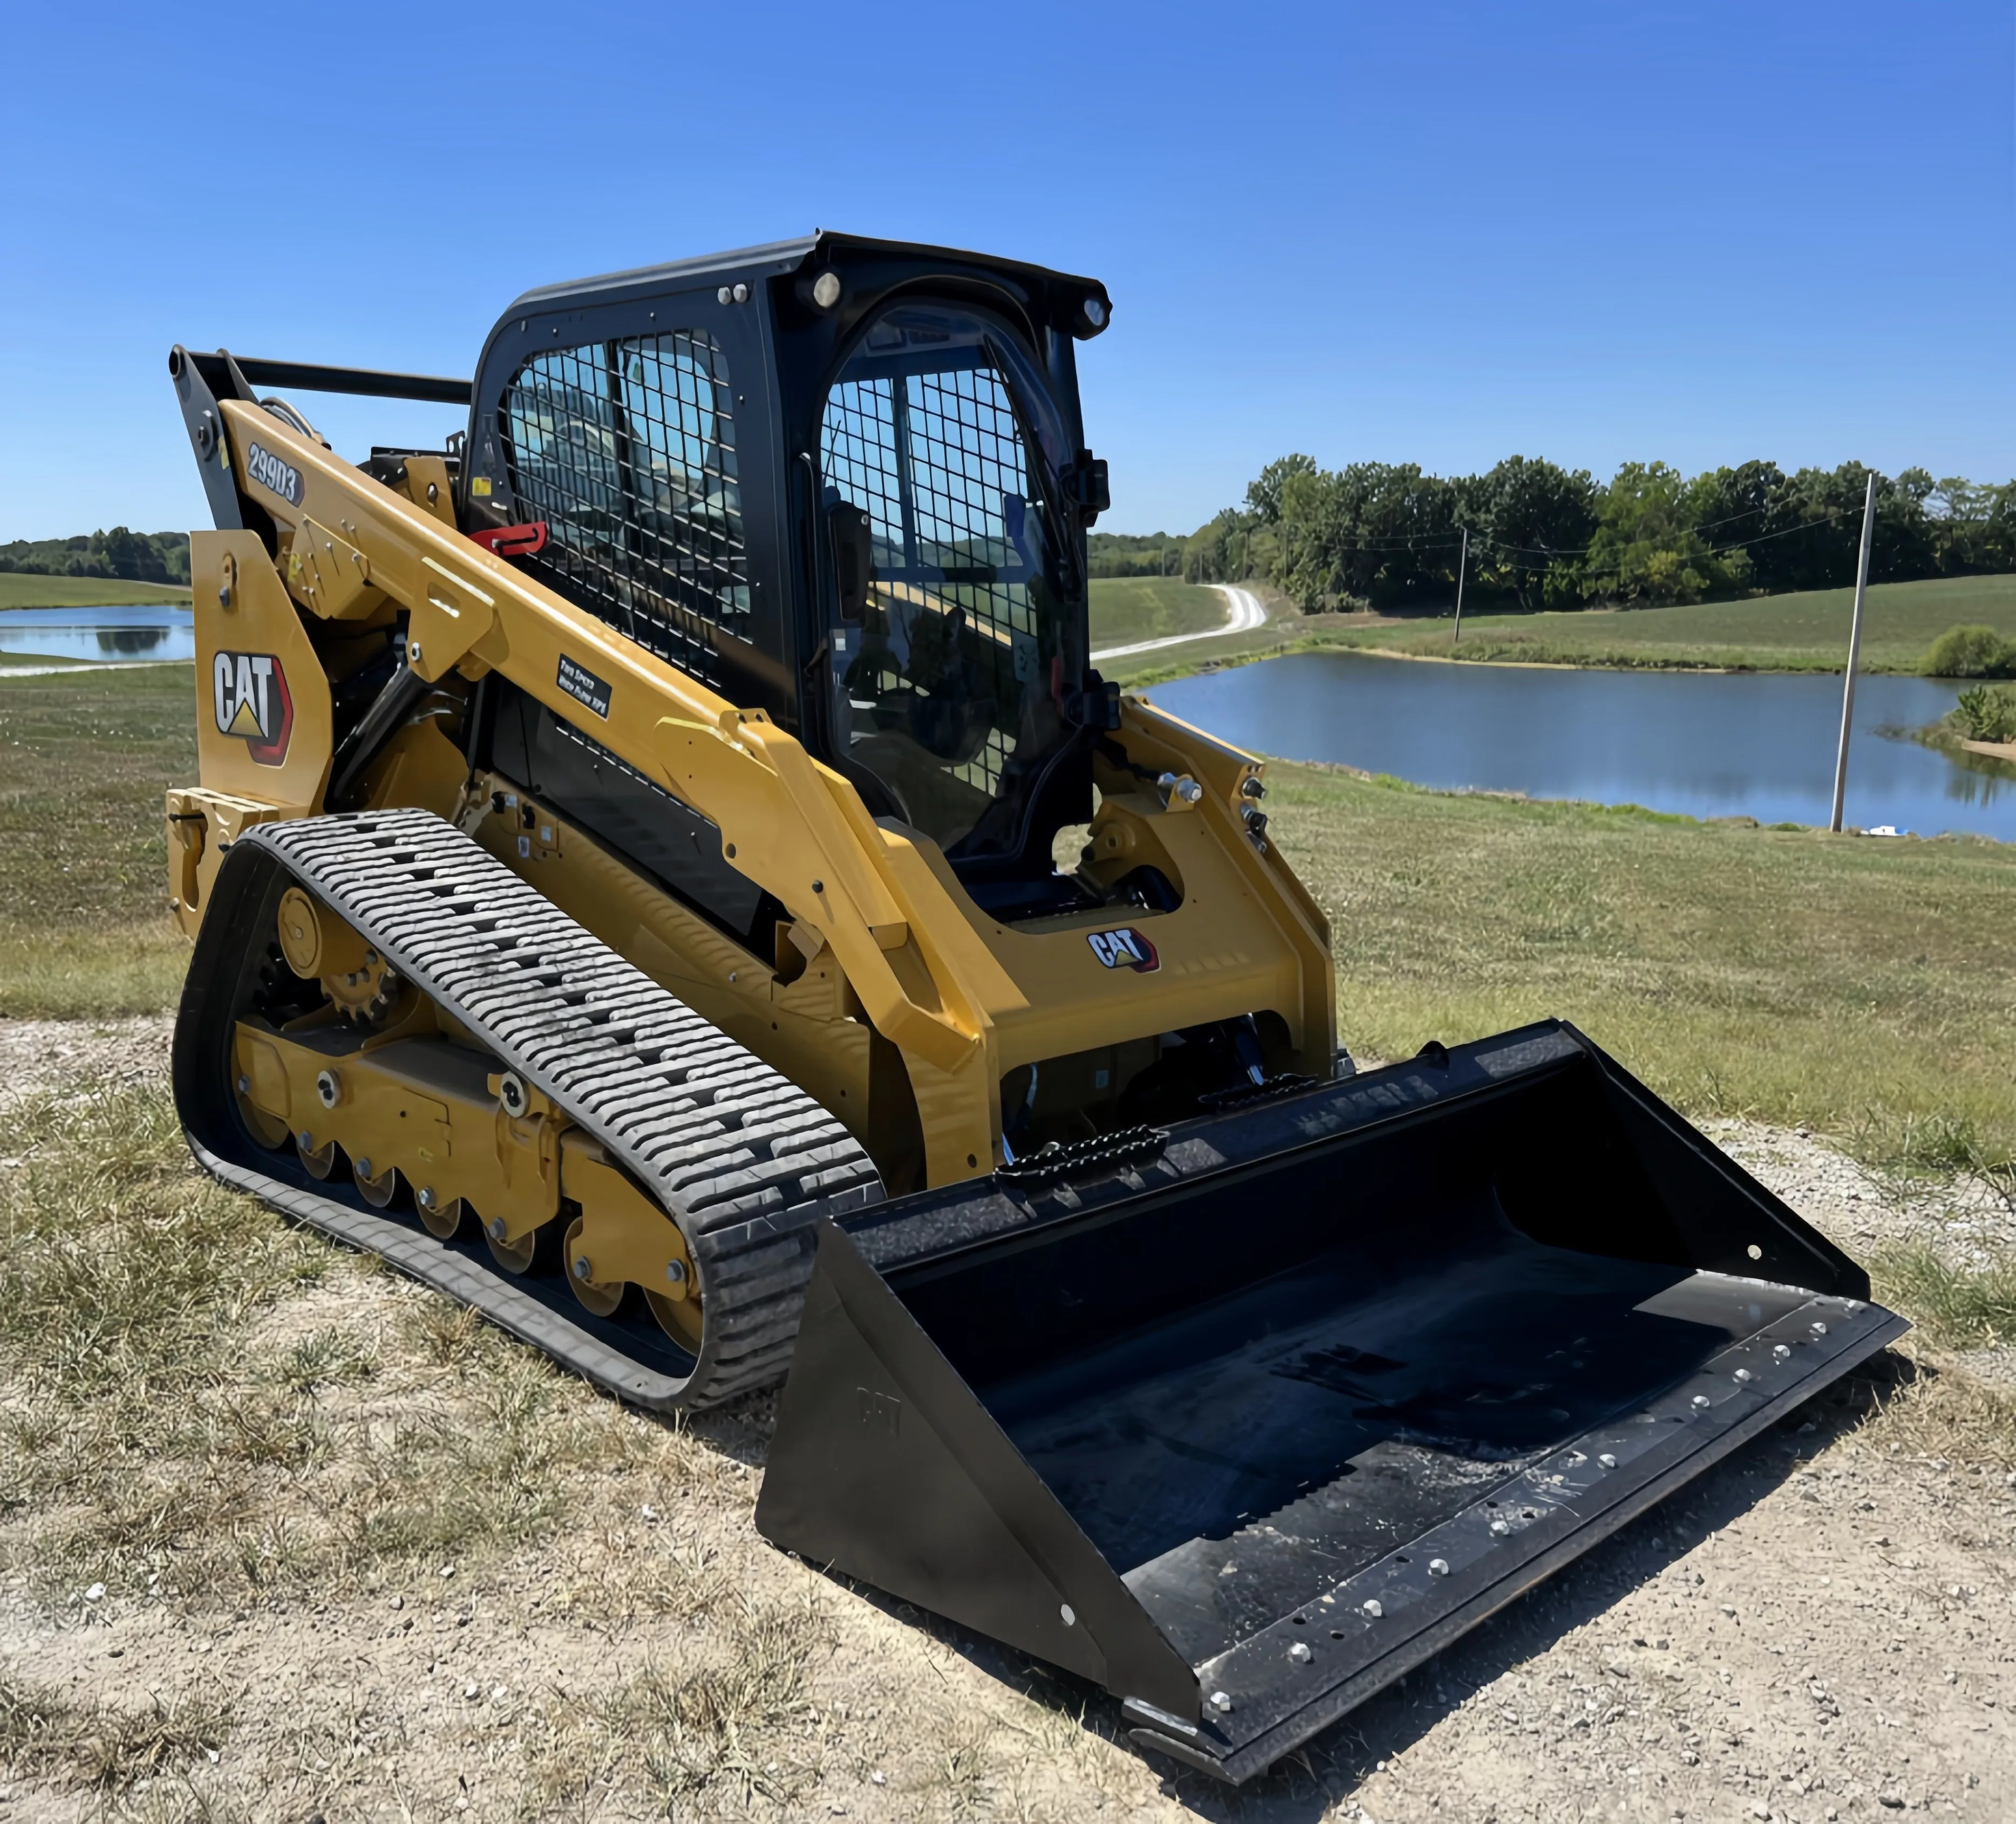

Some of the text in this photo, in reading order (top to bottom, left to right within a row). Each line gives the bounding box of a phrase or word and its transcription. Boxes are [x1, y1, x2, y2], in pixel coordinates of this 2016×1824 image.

[248, 443, 296, 501] 299D3
[214, 654, 272, 738] CAT
[1088, 929, 1144, 967] CAT
